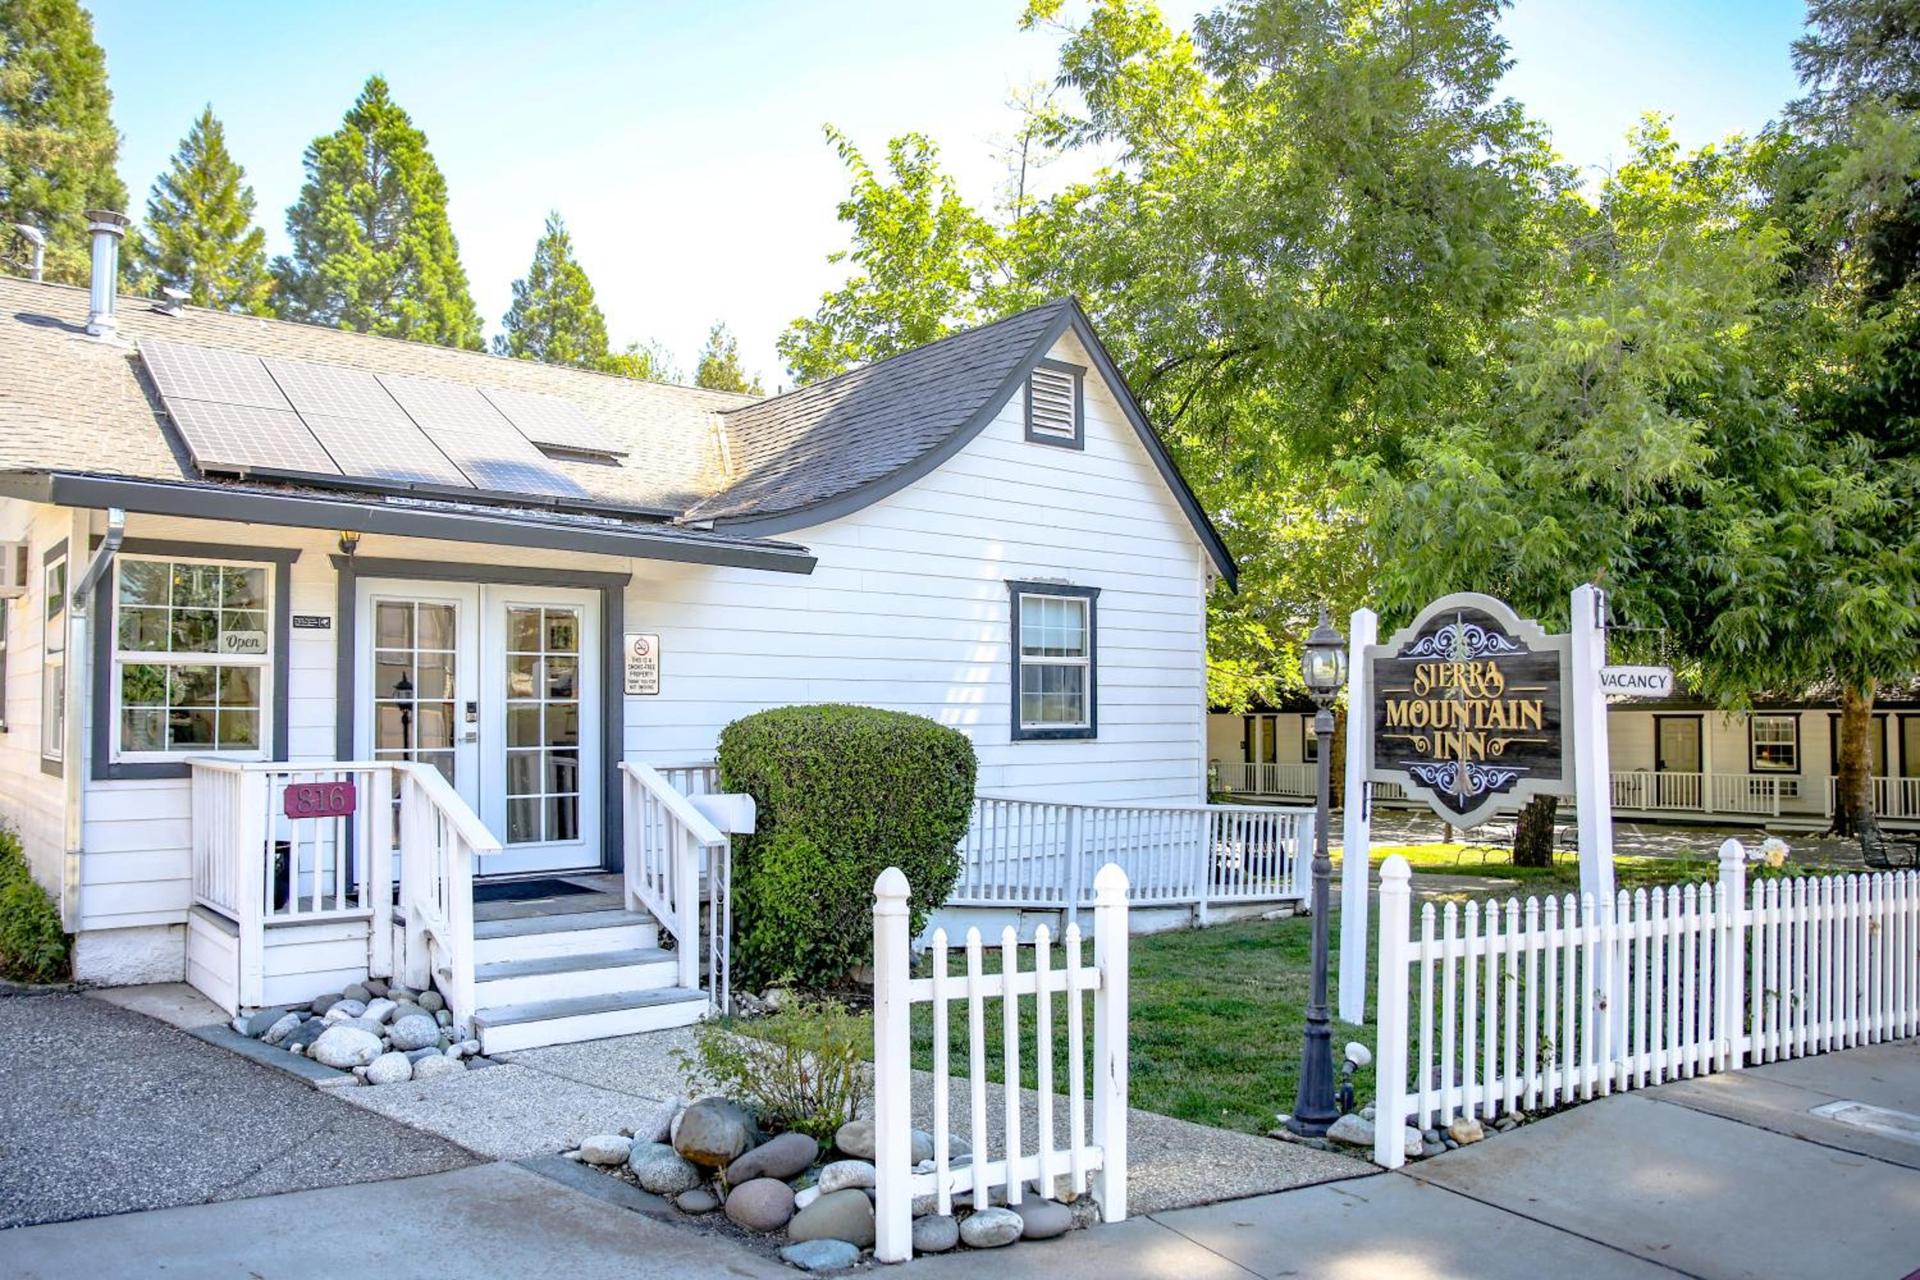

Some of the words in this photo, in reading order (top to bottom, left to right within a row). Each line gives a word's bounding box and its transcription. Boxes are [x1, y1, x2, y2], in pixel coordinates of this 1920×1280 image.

[225, 634, 260, 651] Open
[1413, 660, 1505, 699] SIERRA
[1600, 673, 1668, 689] VACANCY
[1385, 699, 1543, 731] MOUNTAIN
[1433, 731, 1487, 761] INN
[297, 785, 345, 814] 816
